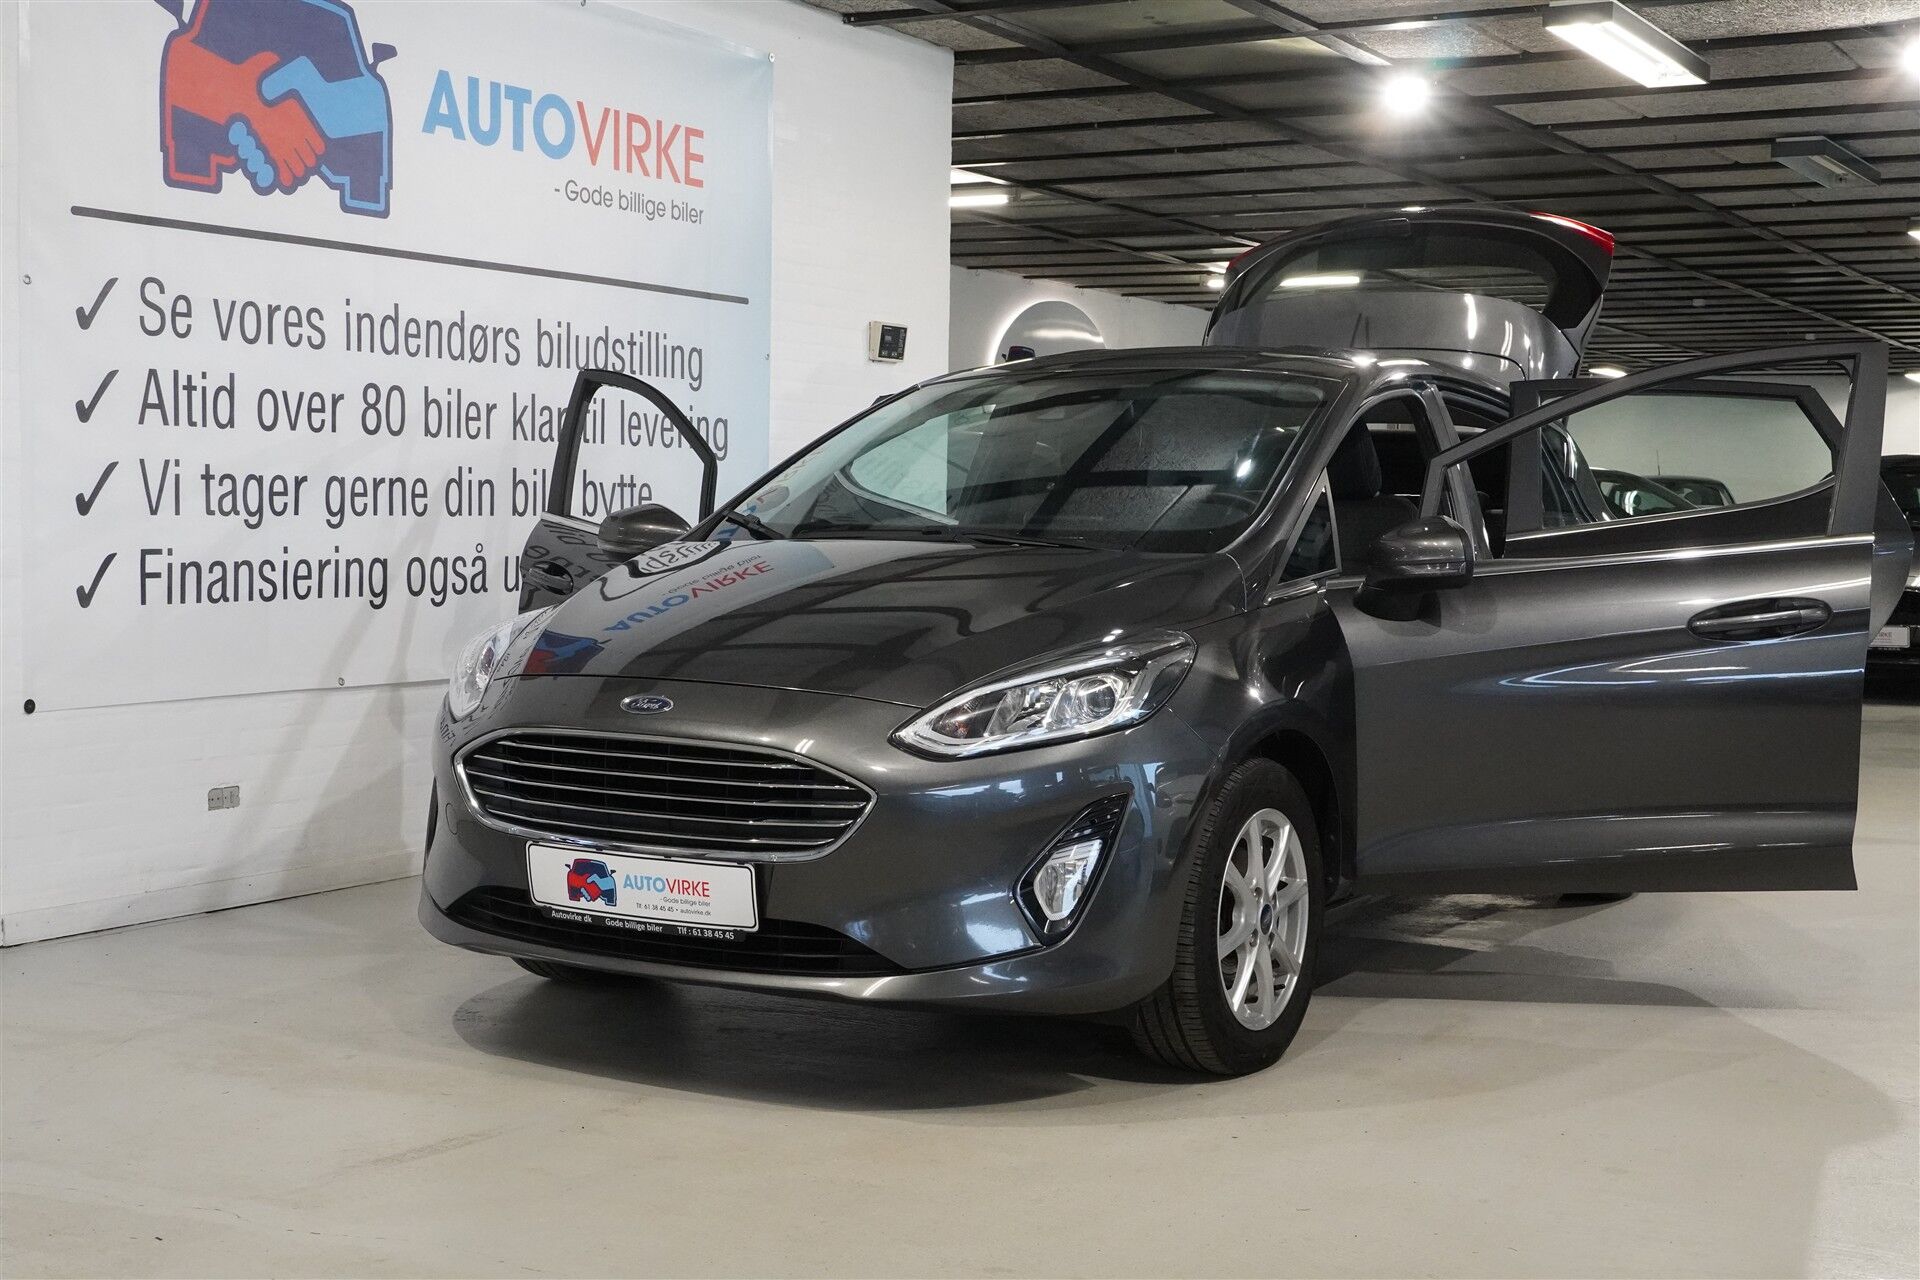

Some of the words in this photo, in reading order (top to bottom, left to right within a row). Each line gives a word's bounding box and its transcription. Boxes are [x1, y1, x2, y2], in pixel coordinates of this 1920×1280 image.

[422, 69, 704, 188] AUTOVIRKE
[565, 179, 613, 207] Gode
[618, 189, 666, 221] billige
[671, 199, 704, 225] biler
[139, 276, 192, 338] Se
[213, 298, 326, 350] vores
[345, 298, 521, 366] indendørs
[537, 318, 703, 392] biludstilling
[138, 368, 235, 429] Altid
[257, 386, 344, 433] over
[361, 382, 406, 436] 80
[424, 385, 497, 440] biler
[512, 392, 568, 443] klar
[139, 458, 181, 516] Vi
[201, 463, 308, 529] tager
[325, 474, 428, 529] gerne
[444, 466, 495, 517] din
[511, 467, 547, 517] bil
[582, 469, 653, 518] bytte
[140, 545, 388, 610] Finansiering
[406, 542, 488, 607] også
[623, 874, 710, 897] AUTOVIRKE
[663, 896, 679, 904] Gode
[680, 898, 697, 906] billige
[605, 917, 623, 928] Gode
[625, 920, 645, 931] billige
[647, 923, 663, 933] biler
[693, 928, 701, 936] 61
[704, 929, 713, 938] 38
[714, 930, 723, 939] 45
[725, 931, 735, 940] 45
